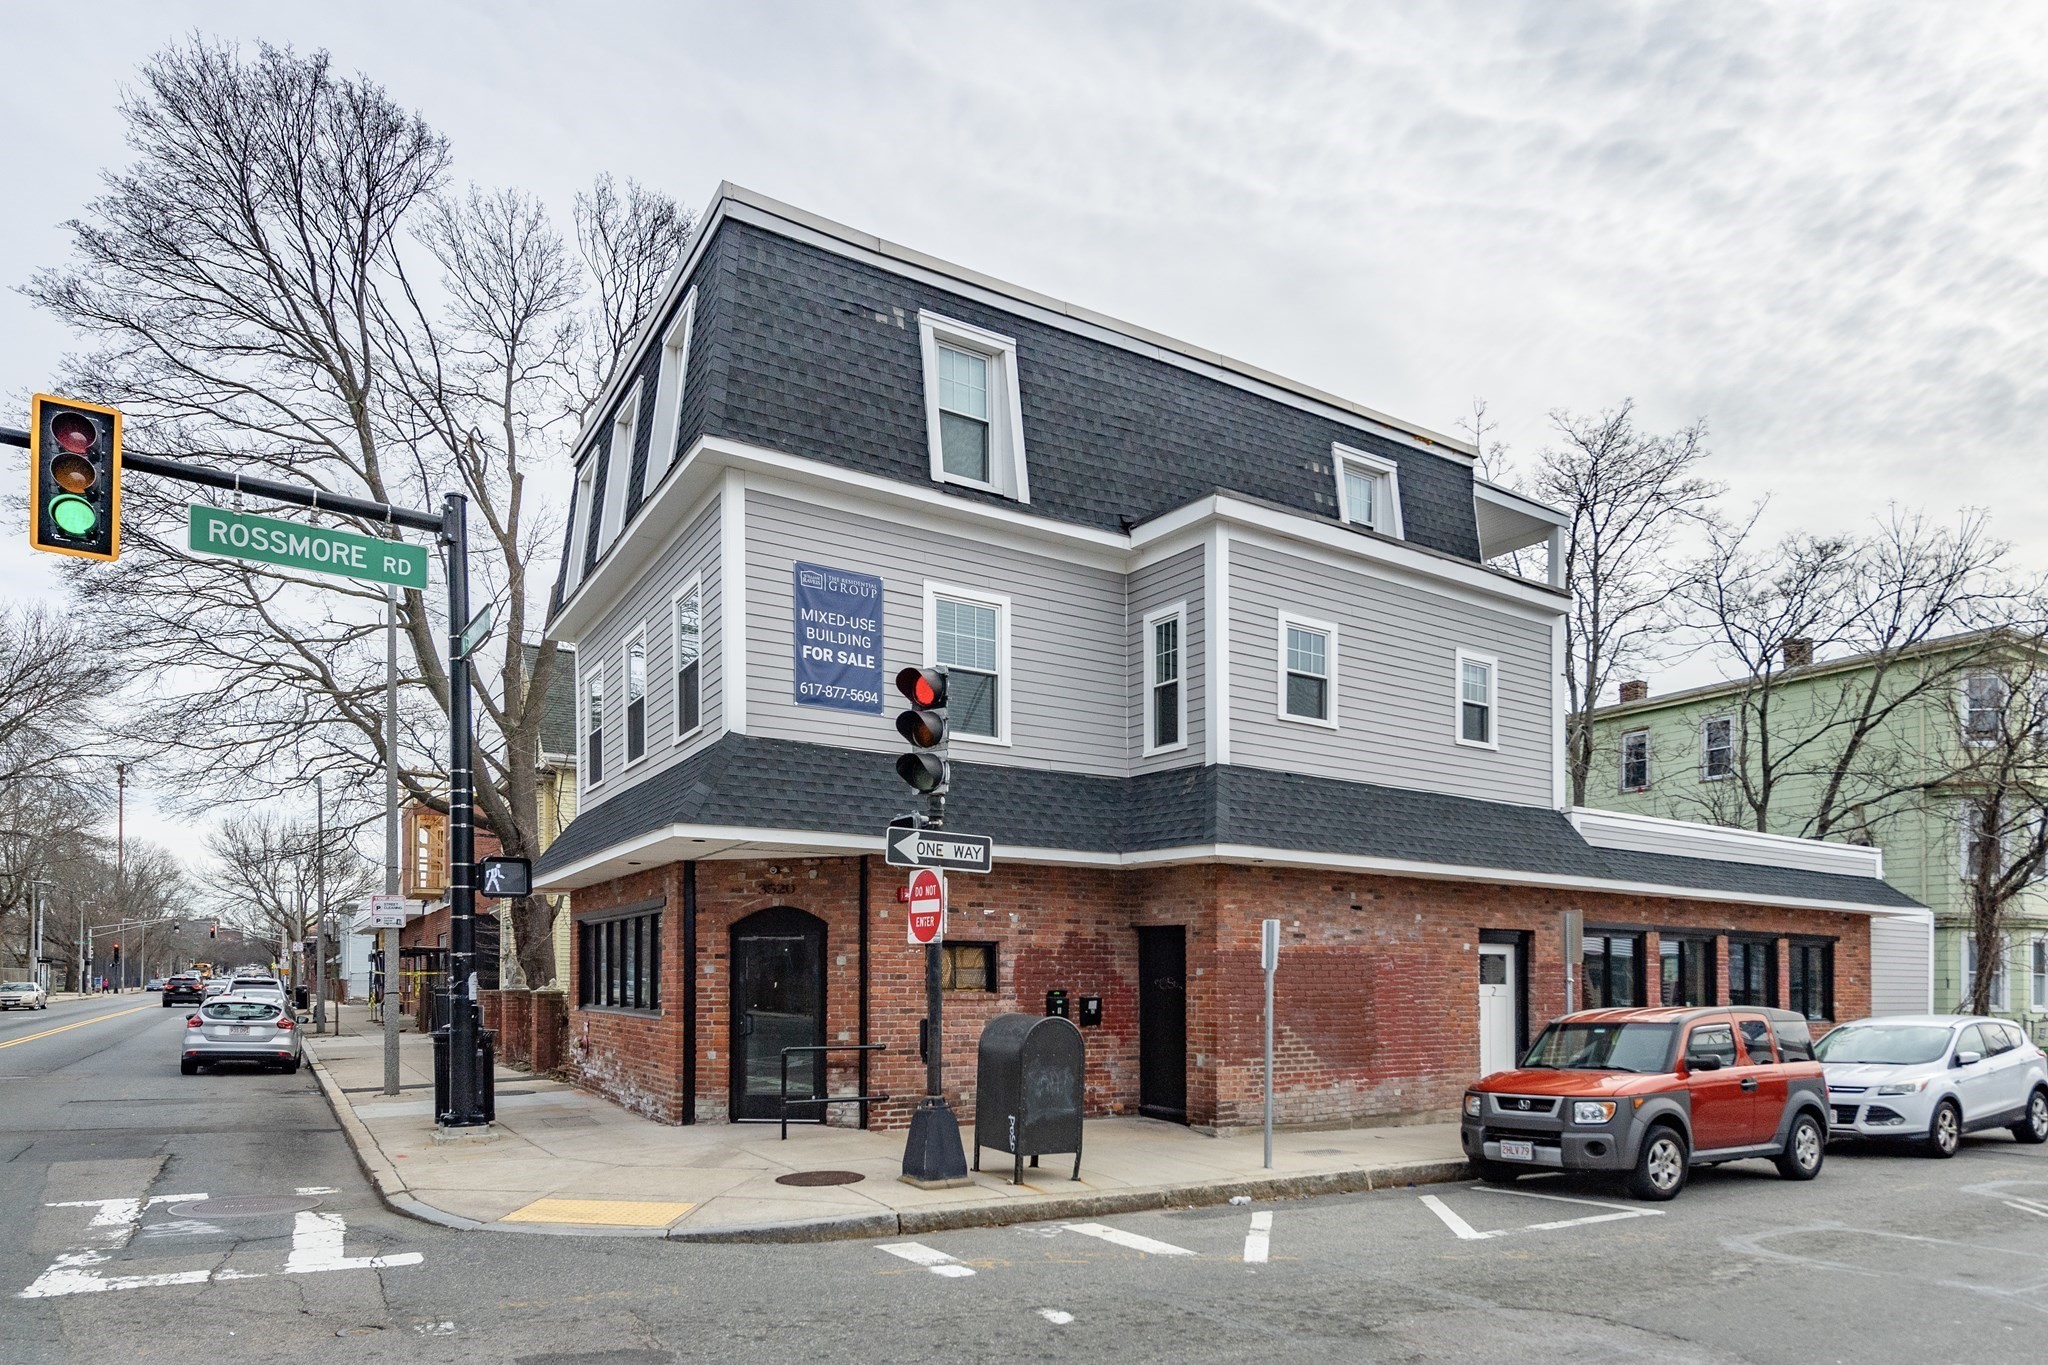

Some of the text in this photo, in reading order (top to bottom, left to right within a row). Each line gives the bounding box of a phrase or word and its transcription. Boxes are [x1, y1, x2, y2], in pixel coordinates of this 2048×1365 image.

[208, 518, 412, 576] ROSSMORE RD
[828, 575, 877, 589] THE RESIDENTIAL
[828, 581, 878, 598] GROUP
[801, 608, 876, 632] MIXED-USE
[806, 627, 871, 649] BUILDING
[802, 645, 875, 669] FOR SALE
[800, 681, 879, 704] 617-877-5694
[916, 841, 982, 860] ONE WAY
[915, 885, 937, 897] DO NOT
[915, 916, 935, 928] ENTER
[1491, 986, 1497, 997] 2
